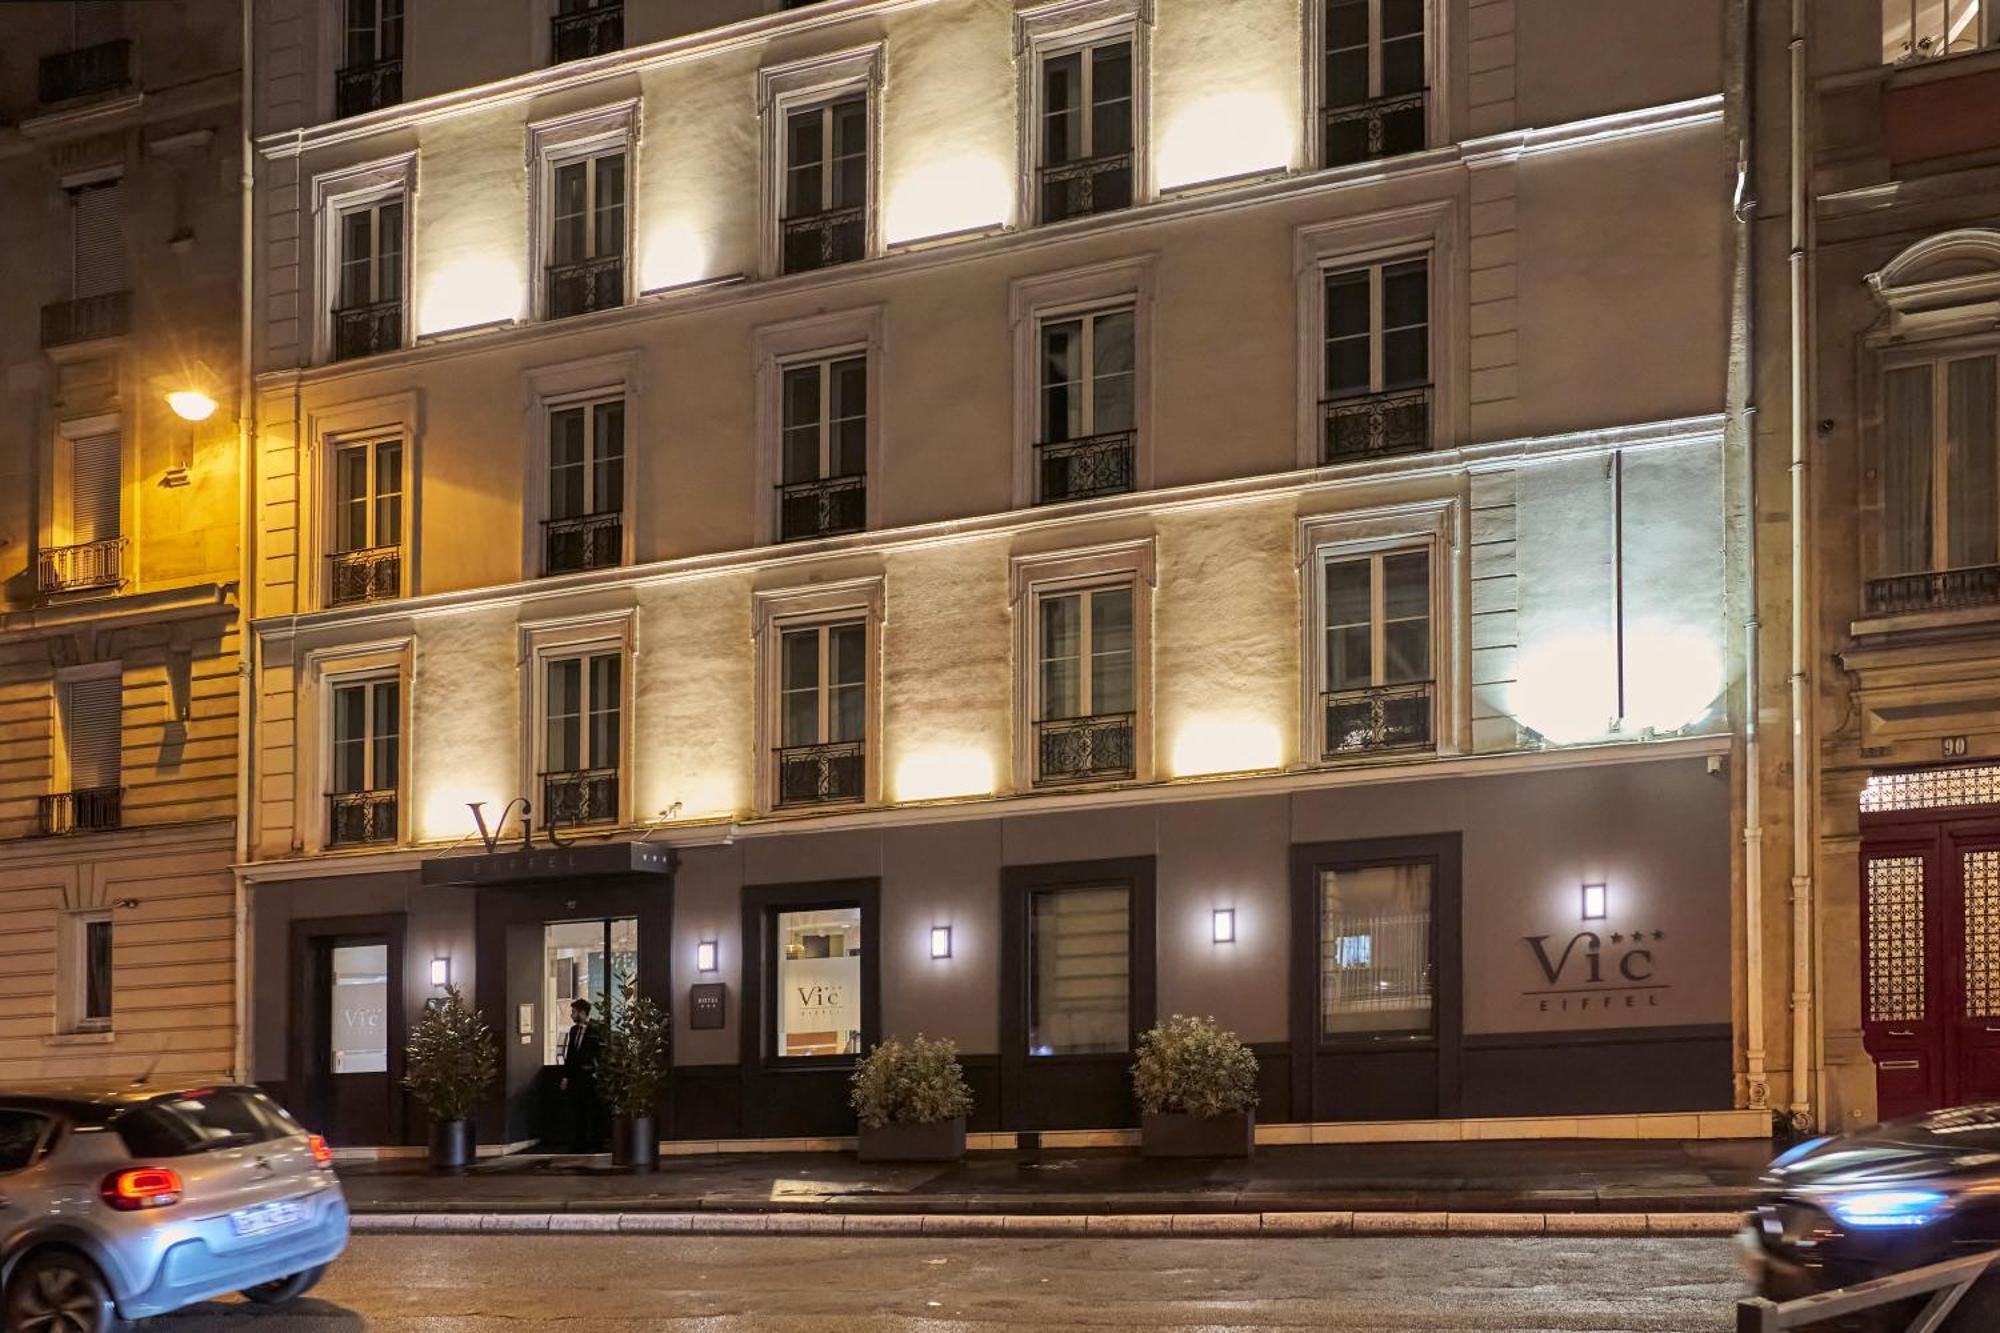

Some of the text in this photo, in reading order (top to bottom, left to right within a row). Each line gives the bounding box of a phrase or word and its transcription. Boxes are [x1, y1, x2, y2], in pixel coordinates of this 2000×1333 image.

[1943, 737, 1966, 756] 90
[465, 797, 577, 854] Vic
[1522, 931, 1654, 985] Vic
[798, 985, 839, 1007] Vic
[1539, 995, 1660, 1012] EIFFEL
[342, 1007, 379, 1027] Vic
